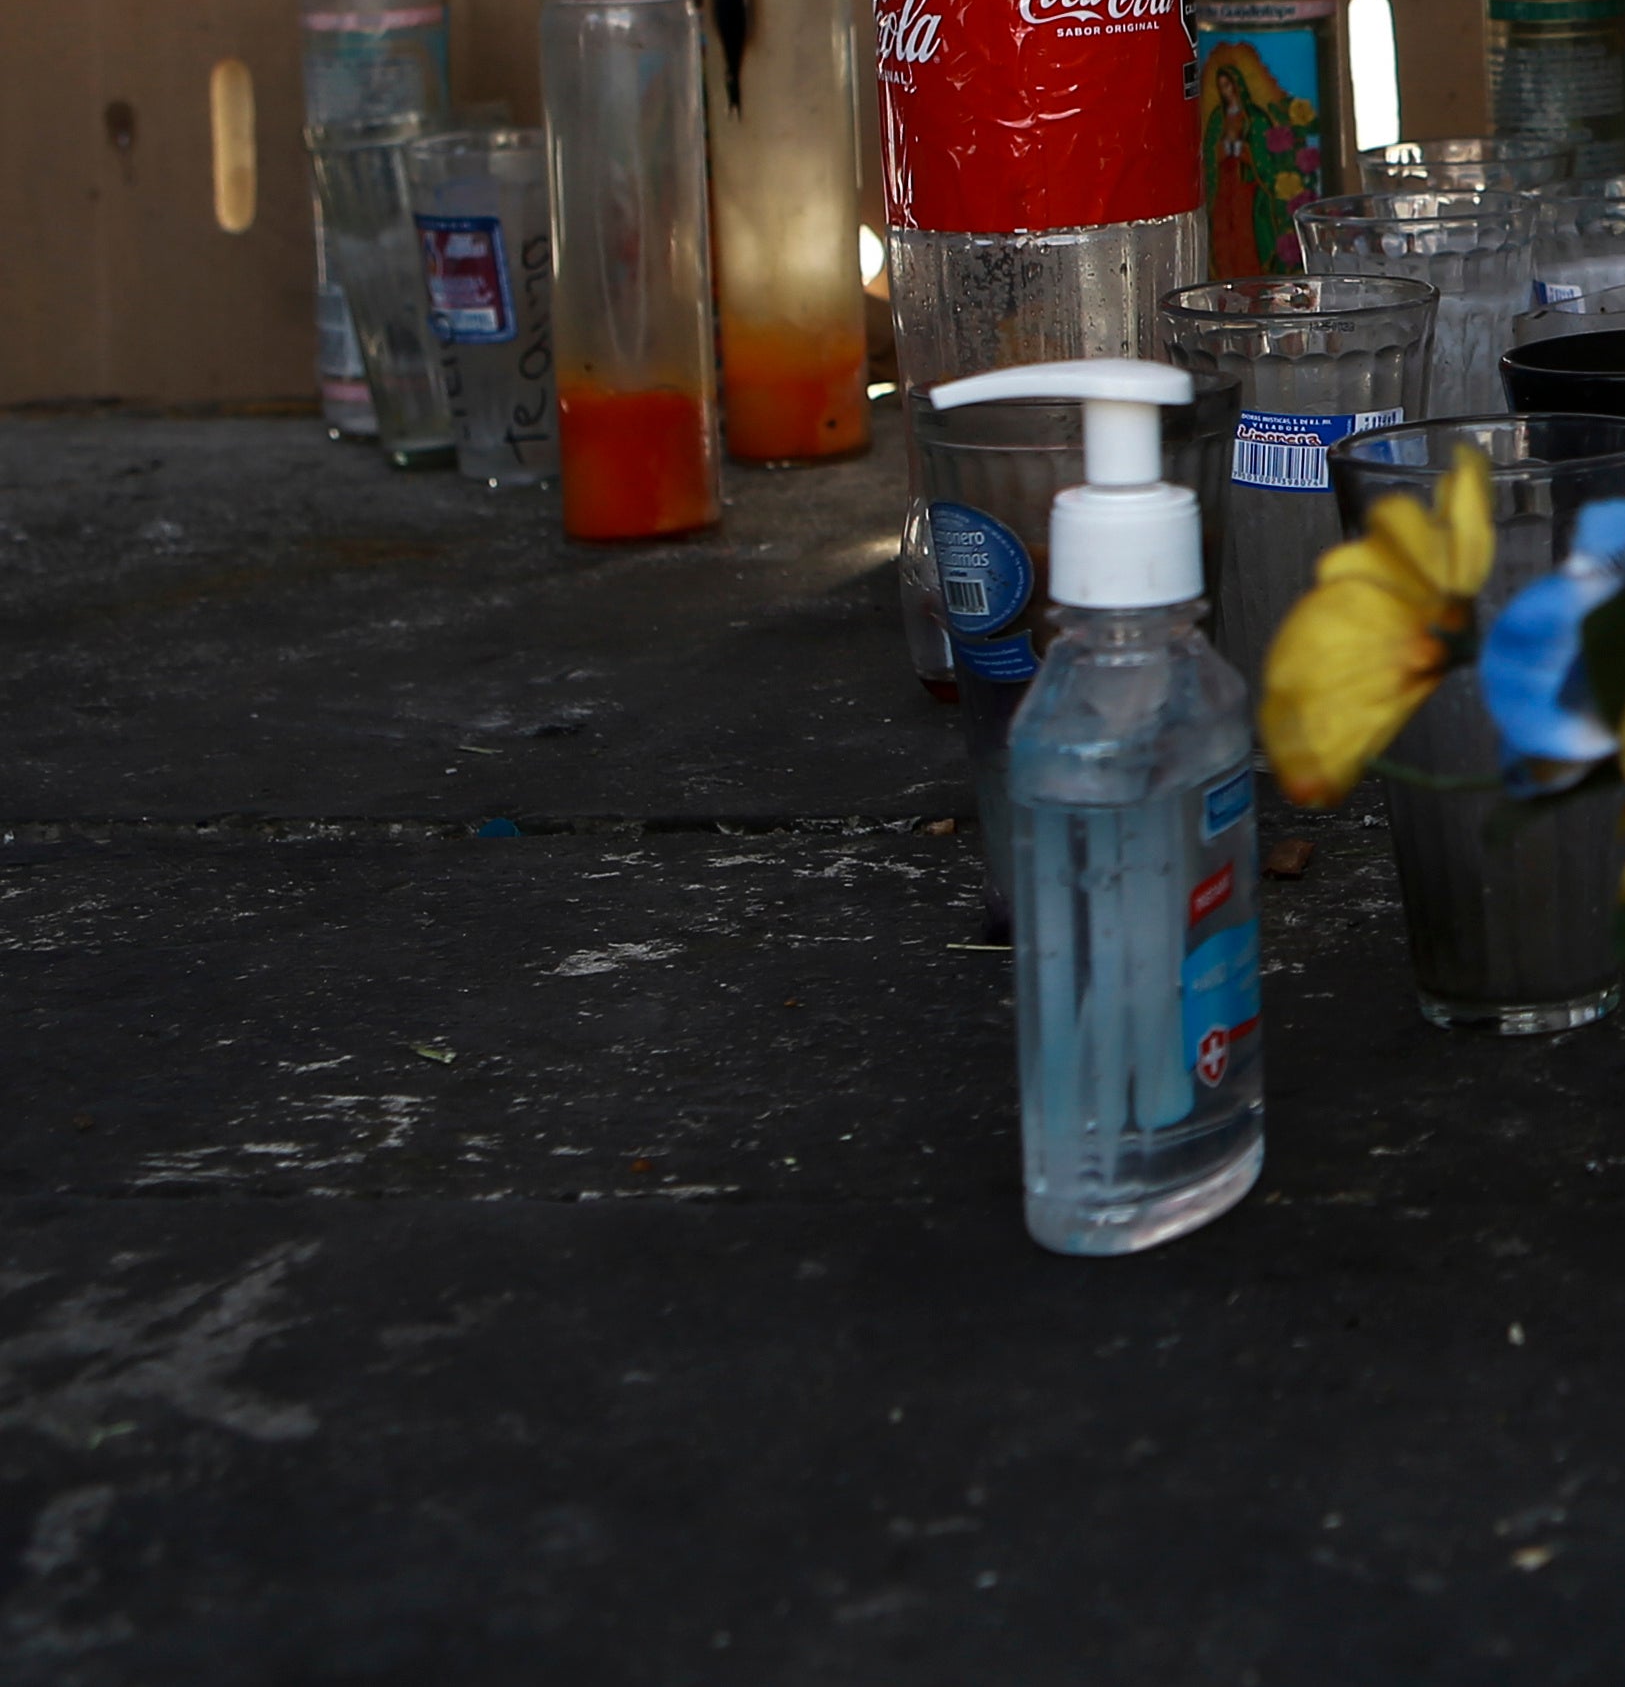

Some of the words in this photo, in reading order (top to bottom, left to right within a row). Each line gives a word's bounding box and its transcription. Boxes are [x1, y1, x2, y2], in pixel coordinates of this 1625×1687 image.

[1056, 25, 1101, 38] SABOR
[1105, 20, 1160, 35] ORIGINAL
[1237, 424, 1322, 445] Limonera
[1252, 421, 1307, 432] VELADORA
